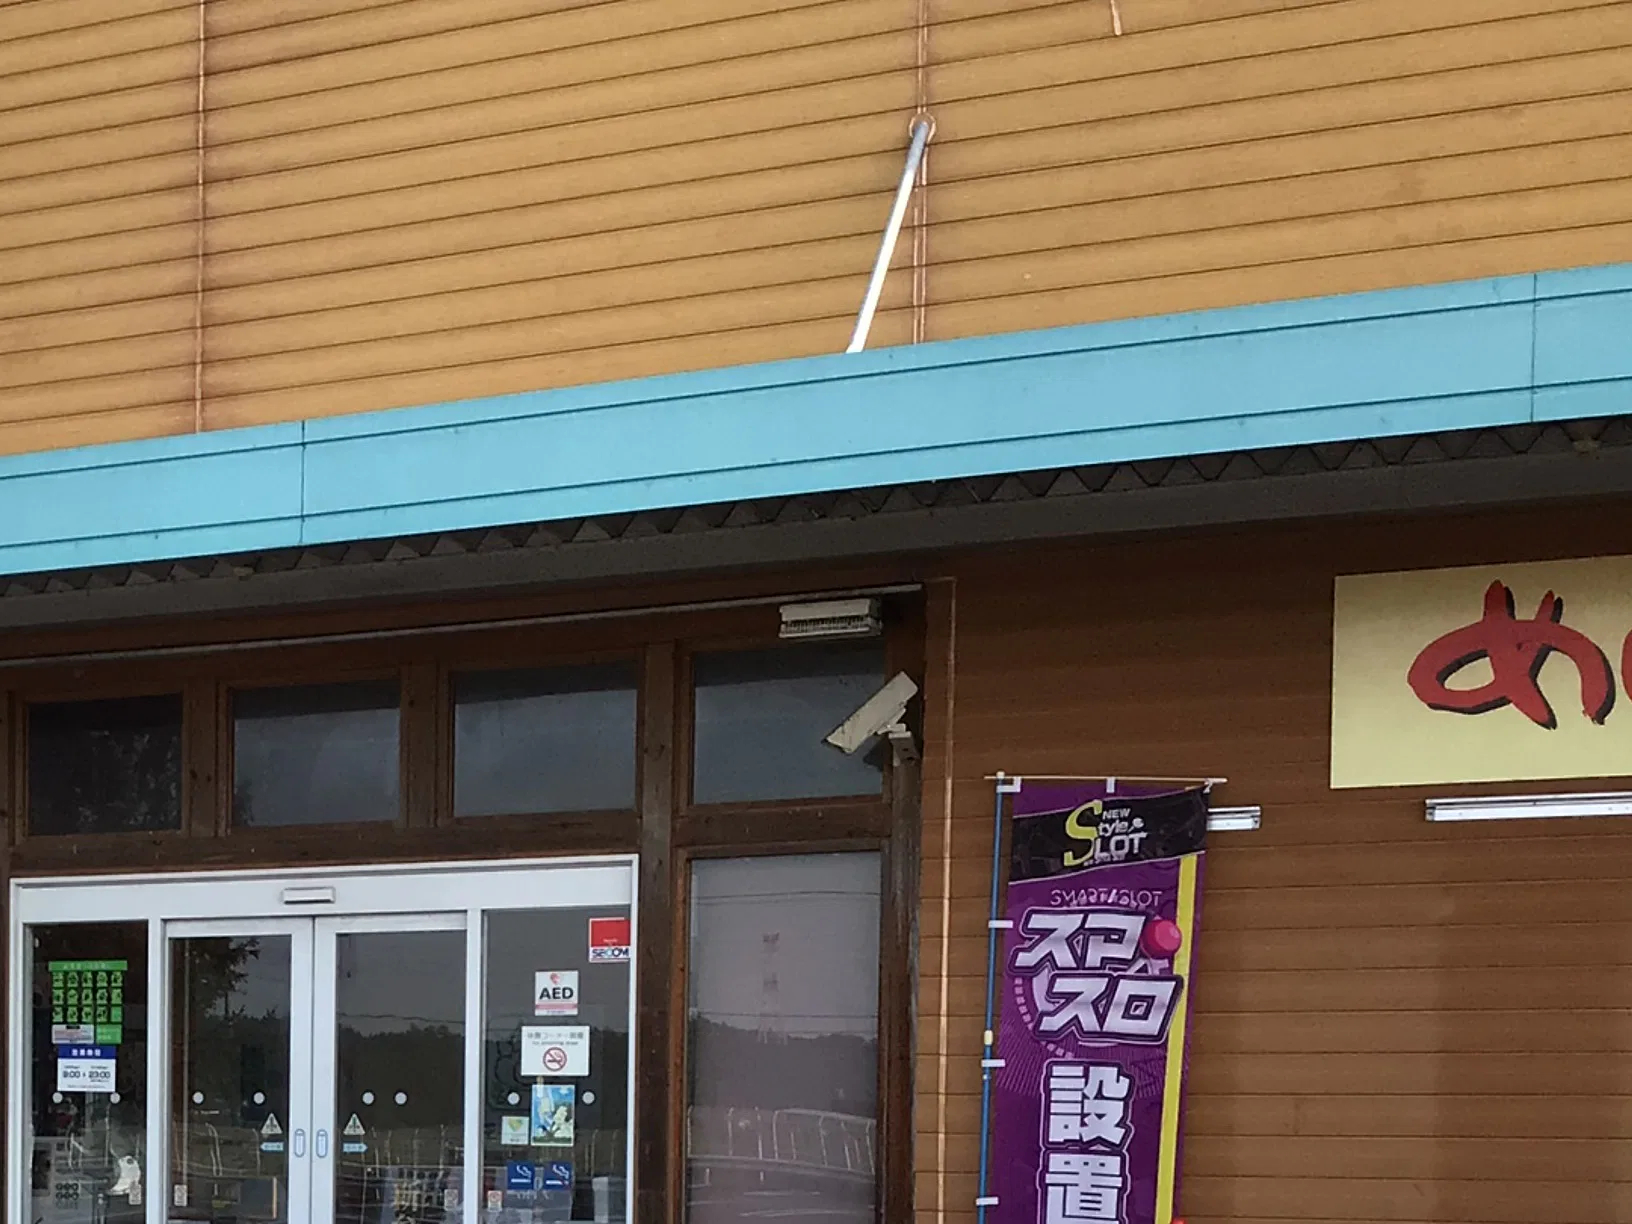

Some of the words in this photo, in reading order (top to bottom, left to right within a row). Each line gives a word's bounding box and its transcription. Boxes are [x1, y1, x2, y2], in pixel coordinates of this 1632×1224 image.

[1406, 579, 1632, 731] め
[1102, 808, 1131, 820] NEW
[539, 986, 574, 1000] AED
